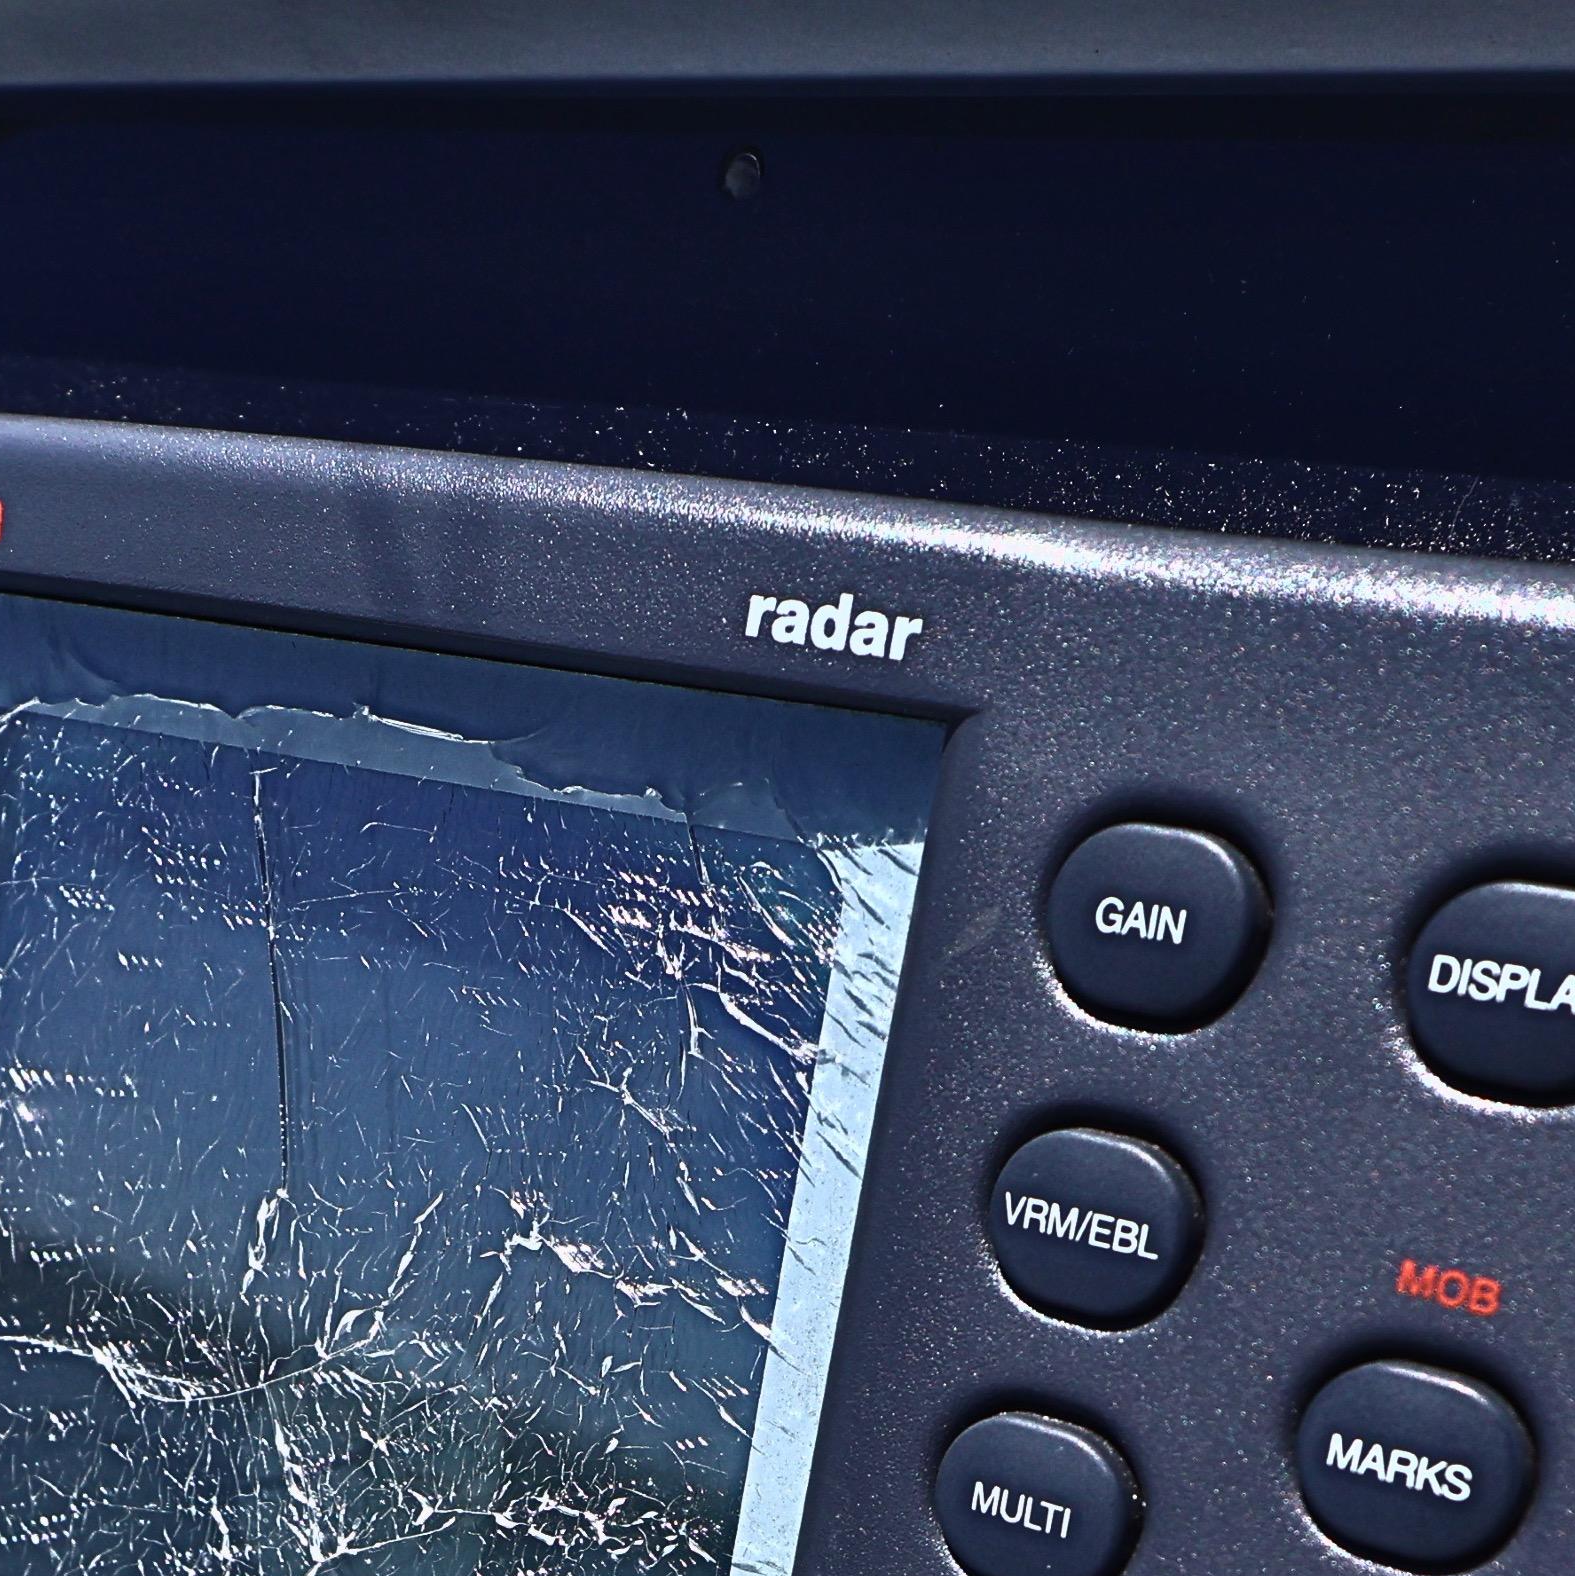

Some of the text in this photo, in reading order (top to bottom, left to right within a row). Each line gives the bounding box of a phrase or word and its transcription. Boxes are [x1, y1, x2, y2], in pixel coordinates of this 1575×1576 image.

[744, 593, 924, 661] radar
[1095, 896, 1187, 945] GAIN
[1004, 1191, 1159, 1260] VRM/EBL
[1396, 1259, 1502, 1316] MOB
[1326, 1432, 1473, 1502] MARKS
[971, 1481, 1071, 1539] MULTI
